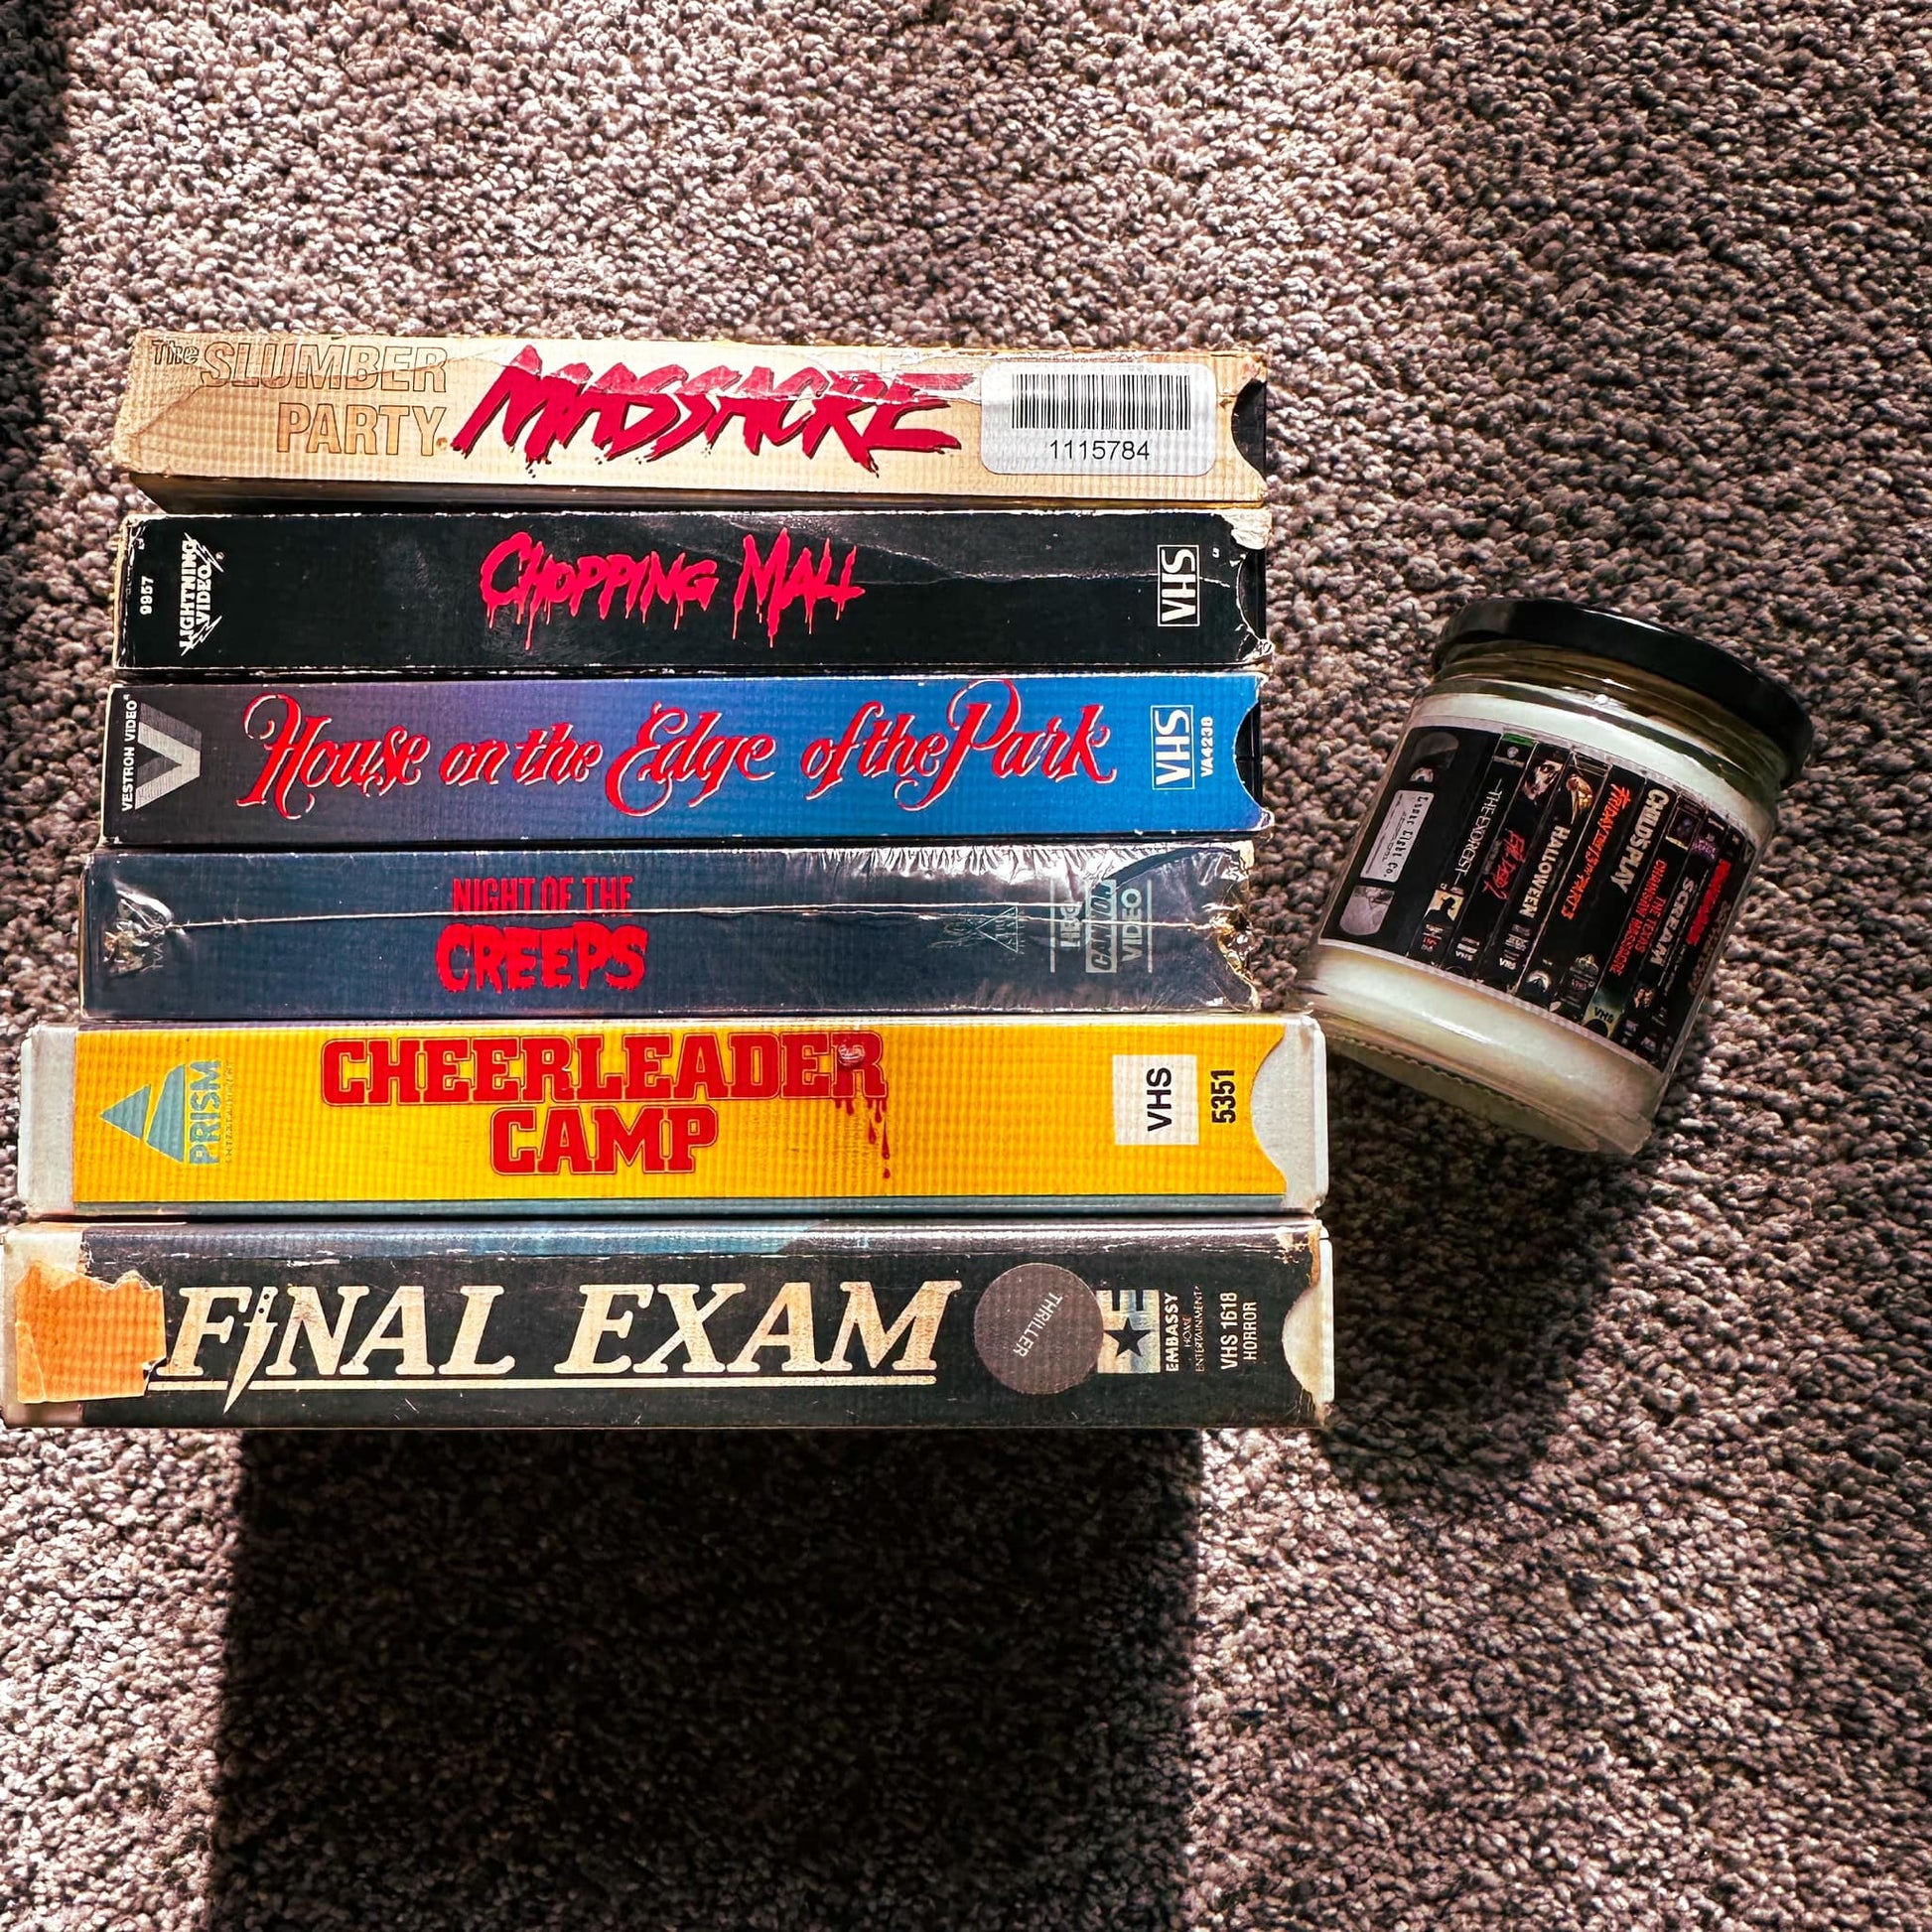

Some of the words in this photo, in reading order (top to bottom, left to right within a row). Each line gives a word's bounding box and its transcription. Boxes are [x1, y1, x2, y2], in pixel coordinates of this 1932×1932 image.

[153, 340, 200, 365] The
[201, 341, 448, 393] SLUMBER
[276, 402, 447, 457] PARTY
[452, 345, 981, 477] MASSACRE
[1049, 439, 1151, 461] 1115784
[179, 537, 199, 650] LIGHTNING
[196, 565, 211, 625] VIDEO
[480, 531, 720, 643] CHOPPING
[733, 526, 866, 648] MALL
[1161, 547, 1196, 624] VHS
[123, 699, 138, 744] VIDEO
[235, 692, 431, 820] House
[439, 739, 510, 787] on
[511, 722, 605, 786] the
[605, 700, 777, 819] Edge
[895, 678, 1118, 813] Park
[1153, 707, 1191, 786] VHS
[121, 746, 136, 812] VESTRON
[1481, 789, 1502, 815] THE
[1597, 783, 1631, 830] FRIDAY
[1454, 814, 1491, 877] EXORCIST
[1519, 825, 1572, 918] HALLOWEEN
[1610, 844, 1645, 894] PLAY
[452, 877, 535, 915] NIGHT
[540, 876, 574, 915] OF
[585, 875, 635, 916] THE
[1635, 858, 1668, 918] CHAINSAW
[1651, 895, 1668, 919] THE
[1090, 881, 1115, 971] CANNON
[1122, 888, 1143, 963] VIDEO
[1608, 916, 1647, 977] MASSACRE
[1634, 916, 1659, 954] TEXAS
[1648, 876, 1698, 968] SCREAM
[436, 920, 649, 994] CREEPS
[1592, 1006, 1614, 1024] VHS
[321, 1030, 890, 1107] CHEERLEADER
[1147, 1066, 1173, 1132] VHS
[1210, 1069, 1236, 1124] 5351
[189, 1060, 221, 1165] PRISM
[489, 1103, 720, 1176] CAMP
[1012, 1291, 1064, 1358] THRILLER
[1164, 1292, 1179, 1372] EMBASSY
[1184, 1315, 1193, 1347] HOME
[1220, 1292, 1238, 1327] 1618
[1242, 1302, 1258, 1361] HORROR
[156, 1285, 515, 1403] FINAL
[554, 1280, 962, 1375] EXAM
[1220, 1328, 1238, 1371] VHS
